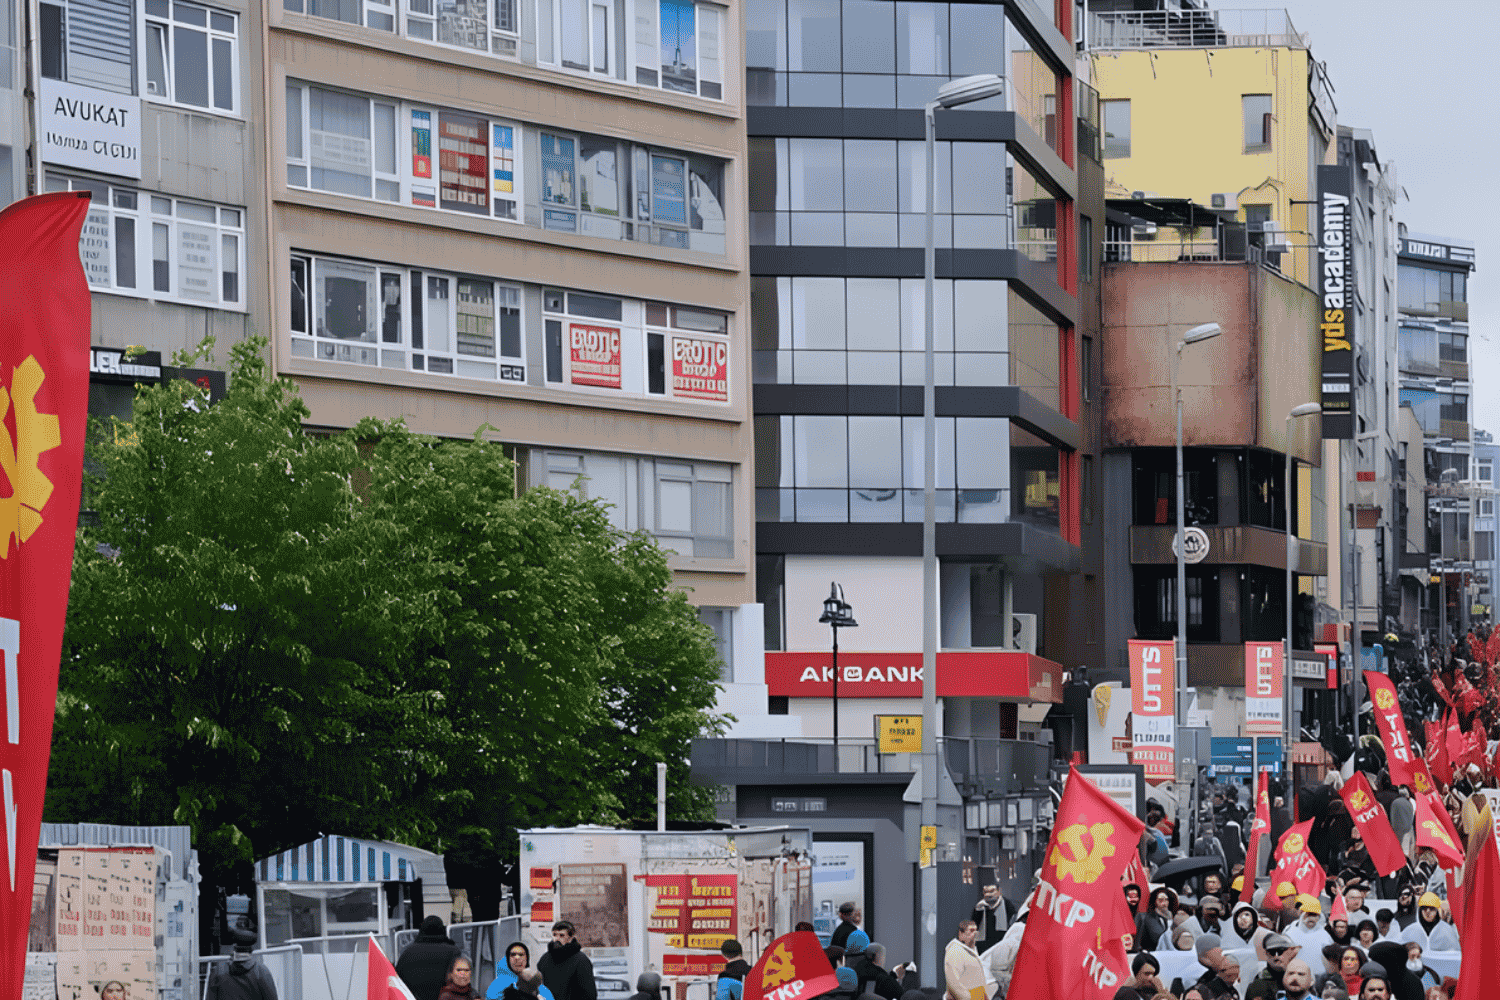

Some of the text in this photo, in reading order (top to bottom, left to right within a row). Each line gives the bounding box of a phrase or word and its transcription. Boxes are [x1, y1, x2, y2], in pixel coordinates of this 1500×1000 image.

[54, 96, 128, 128] AVUKAT
[799, 666, 924, 683] AKBANK
[1036, 880, 1095, 928] TKP
